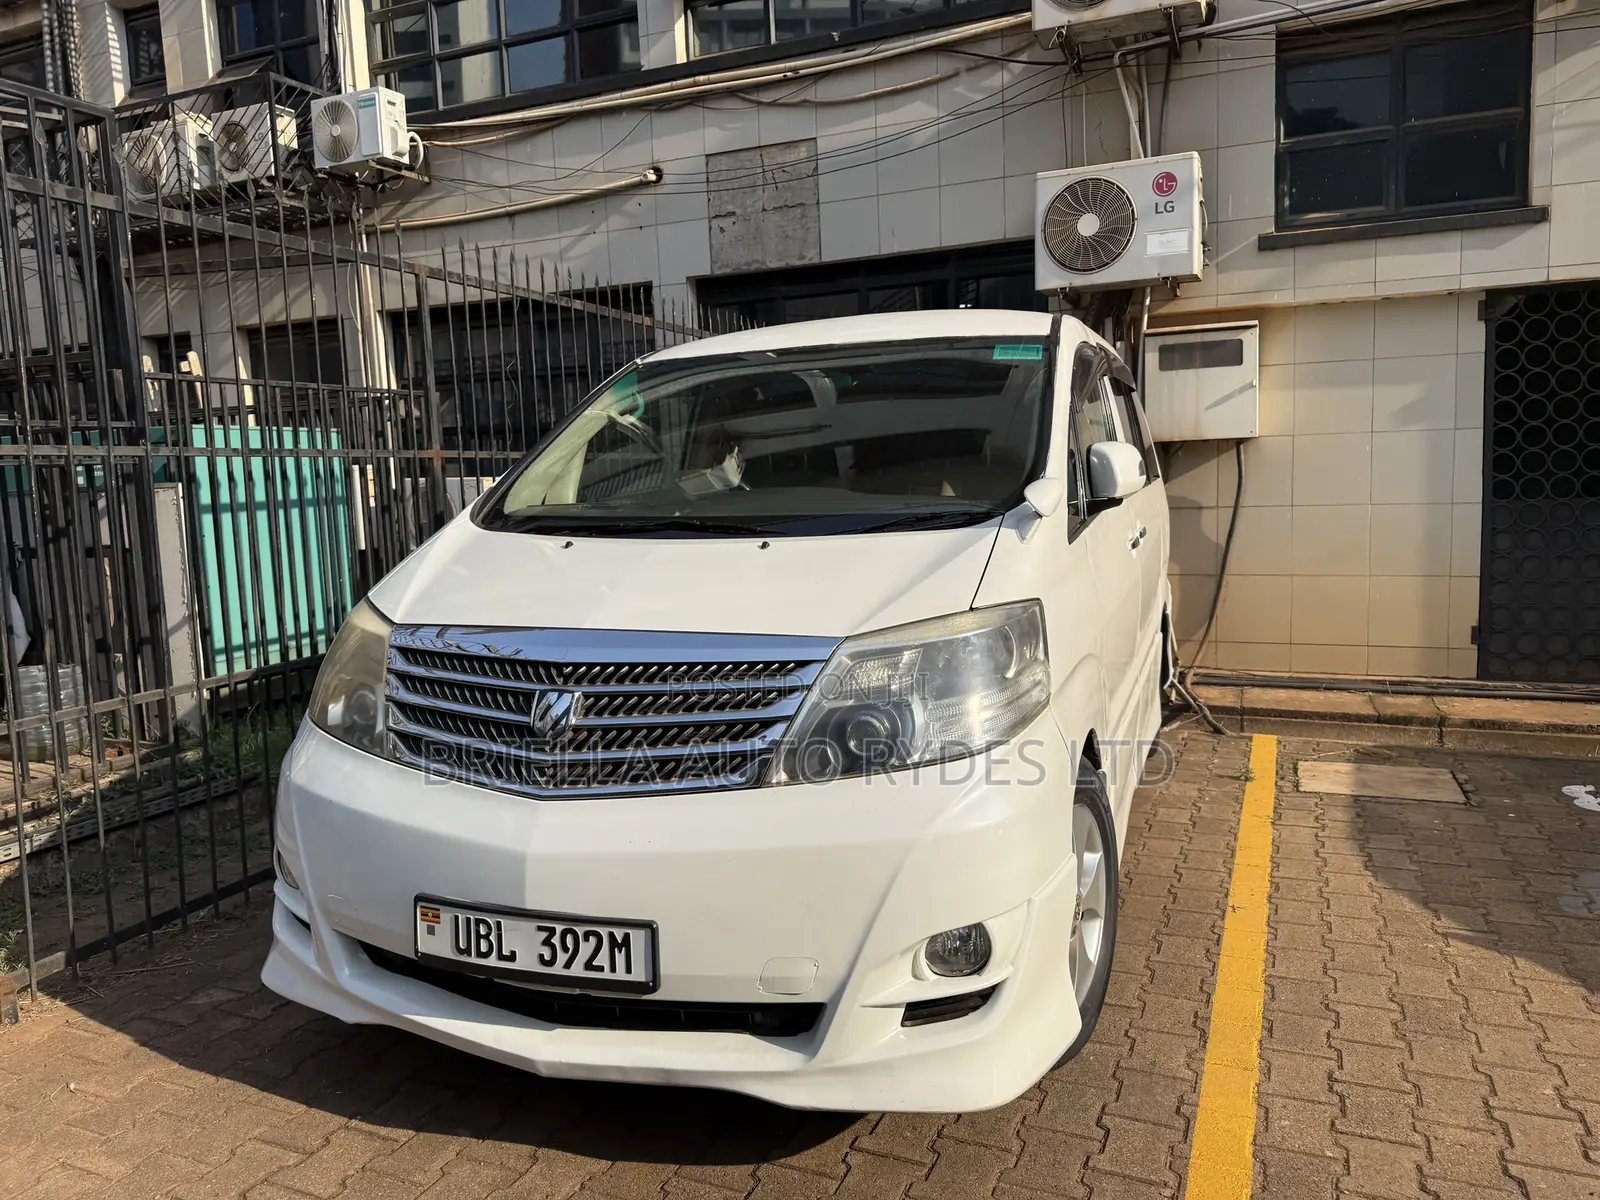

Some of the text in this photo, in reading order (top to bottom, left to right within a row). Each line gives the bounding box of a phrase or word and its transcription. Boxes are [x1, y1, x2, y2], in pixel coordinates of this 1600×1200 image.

[1155, 201, 1175, 214] LG
[454, 914, 633, 975] UBL 392M
